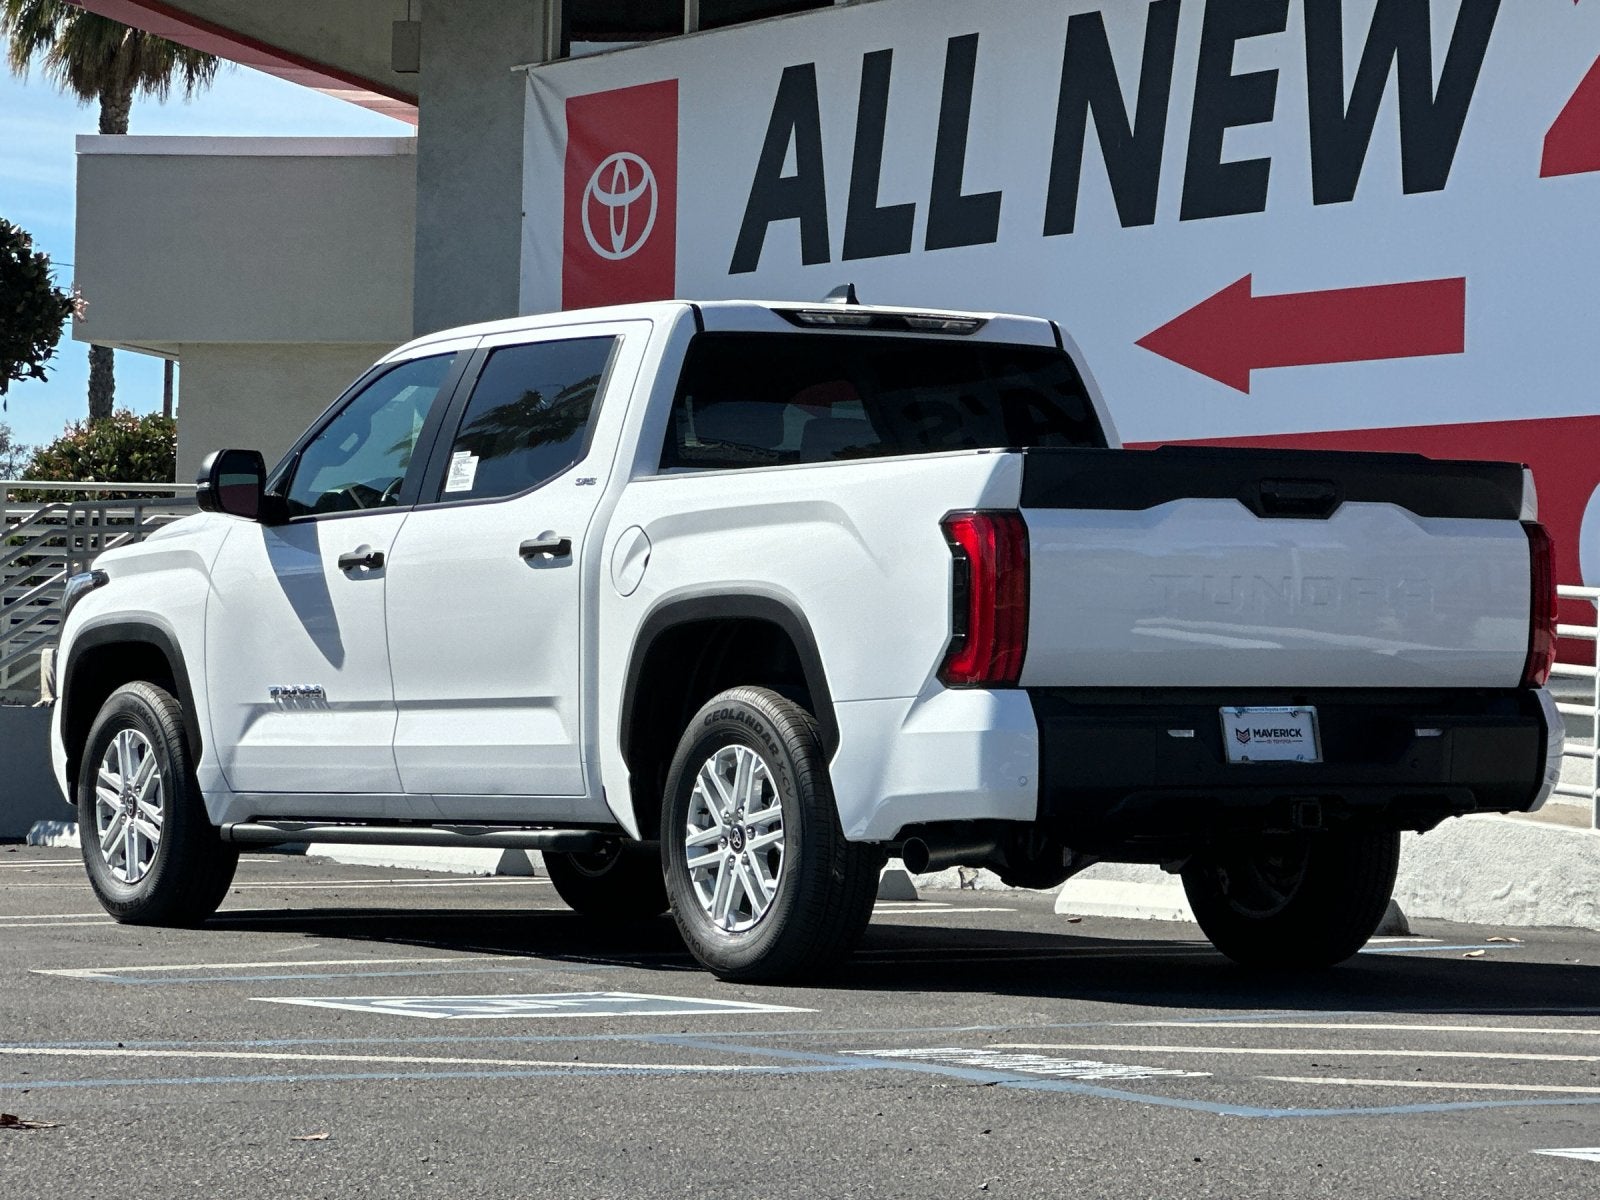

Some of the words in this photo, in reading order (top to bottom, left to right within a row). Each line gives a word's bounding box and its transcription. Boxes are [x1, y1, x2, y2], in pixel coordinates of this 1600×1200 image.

[729, 32, 1003, 275] ALL
[1043, 0, 1501, 236] NEW
[704, 707, 780, 756] GEOLANDAR
[1253, 728, 1303, 738] MAVERICK
